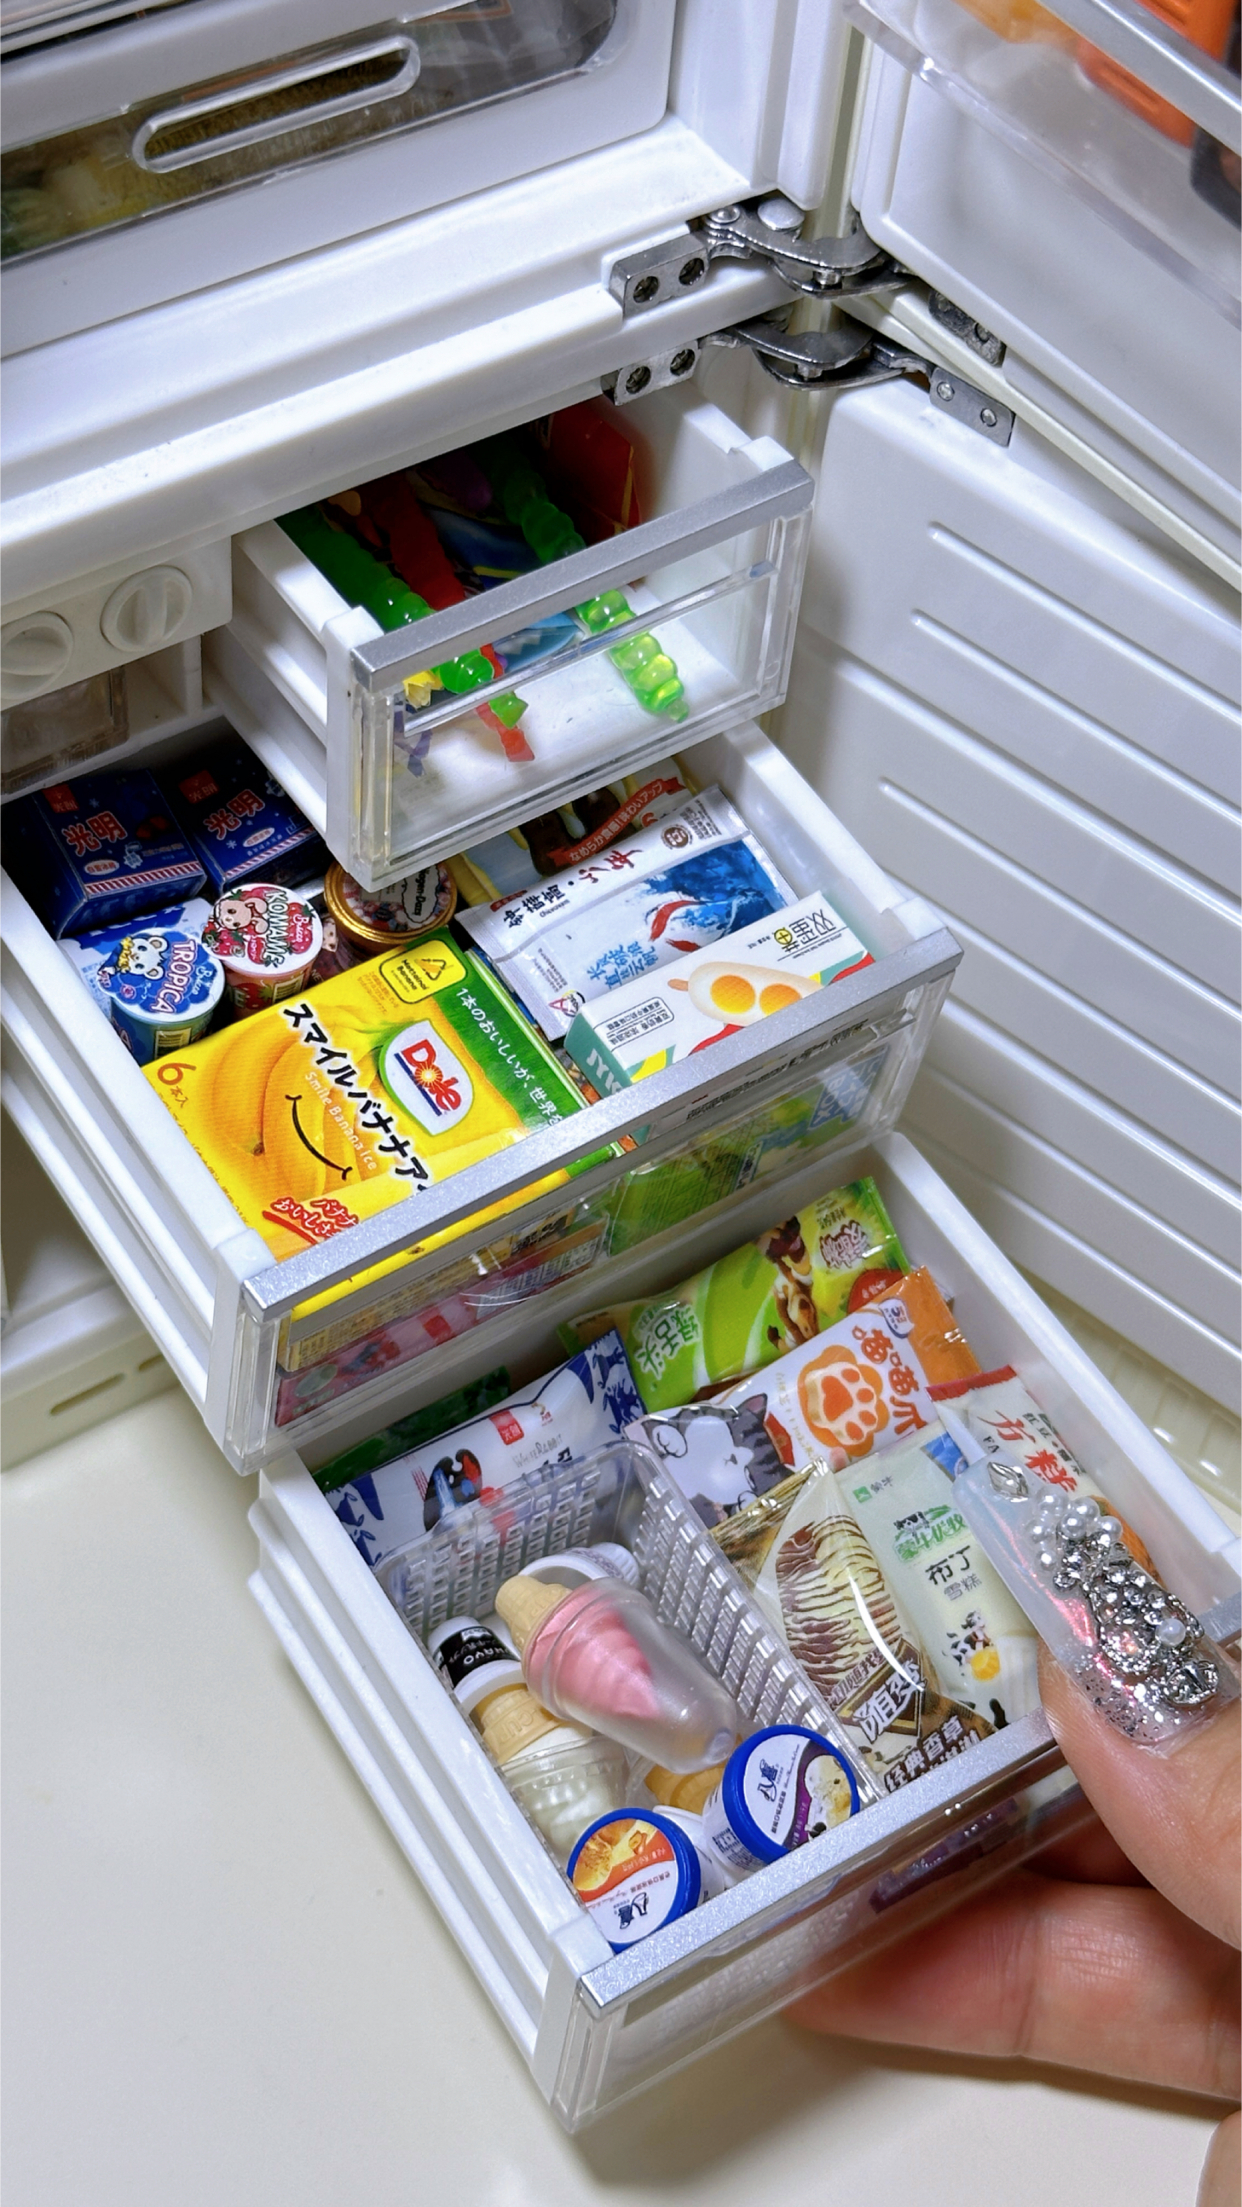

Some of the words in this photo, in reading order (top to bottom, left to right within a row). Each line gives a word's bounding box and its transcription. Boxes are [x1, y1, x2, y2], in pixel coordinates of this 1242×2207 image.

[62, 811, 128, 857] 光明
[203, 789, 265, 840] 光明
[264, 889, 289, 968] KOMAME
[774, 909, 837, 954] 双蛋黄
[151, 939, 198, 1014] TROPICA
[396, 965, 418, 991] Banana
[284, 1003, 430, 1192] スマイルバナナア
[305, 1070, 332, 1105] Smile
[328, 1104, 364, 1152] Banana
[401, 1038, 461, 1111] Dole
[635, 1302, 699, 1380] 绿舌头
[925, 1545, 973, 1587] 布丁
[943, 1575, 983, 1601] 雪糕
[854, 1657, 927, 1743] 随变
[883, 1715, 965, 1792] 经典香草
